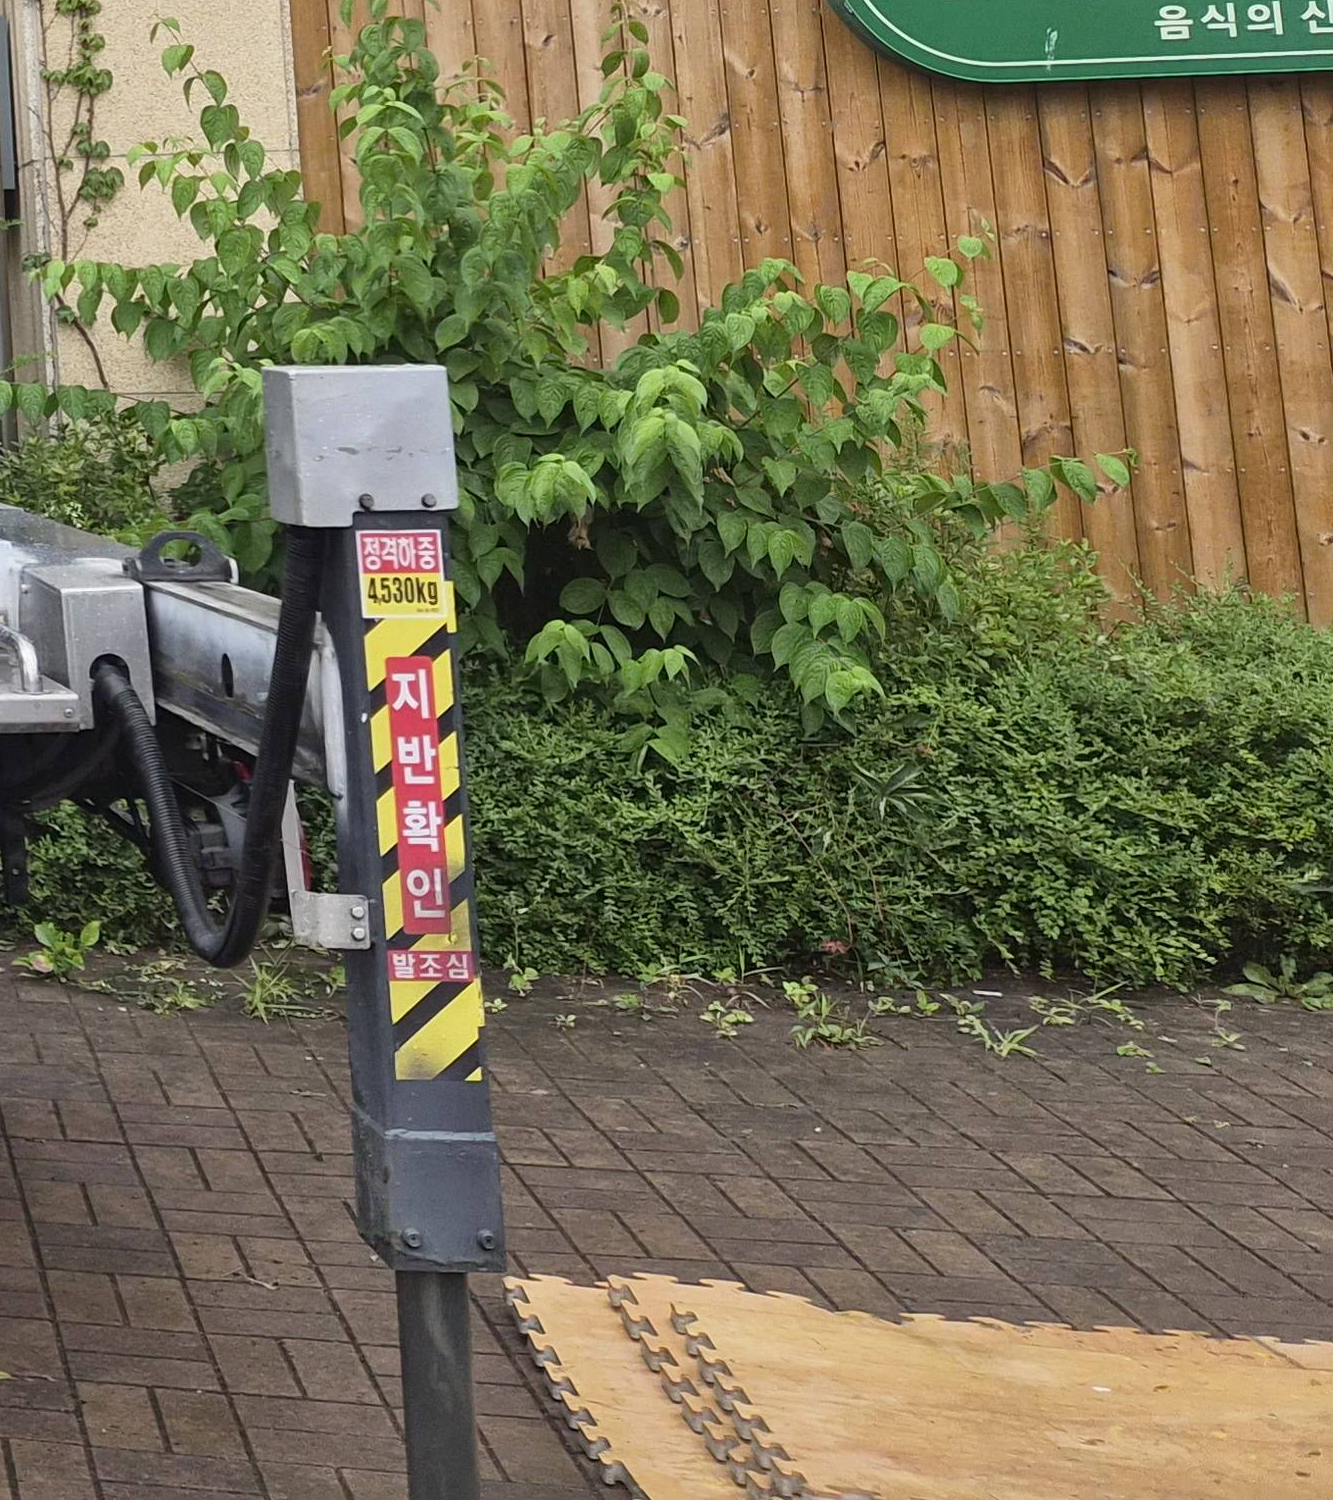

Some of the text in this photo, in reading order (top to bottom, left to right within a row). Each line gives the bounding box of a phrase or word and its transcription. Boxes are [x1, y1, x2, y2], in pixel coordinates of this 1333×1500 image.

[1153, 0, 1284, 41] 음식의
[362, 536, 436, 570] 정격하중
[367, 577, 439, 606] 4,530kg
[392, 669, 445, 918] 지반확인
[392, 953, 470, 979] 발조심
